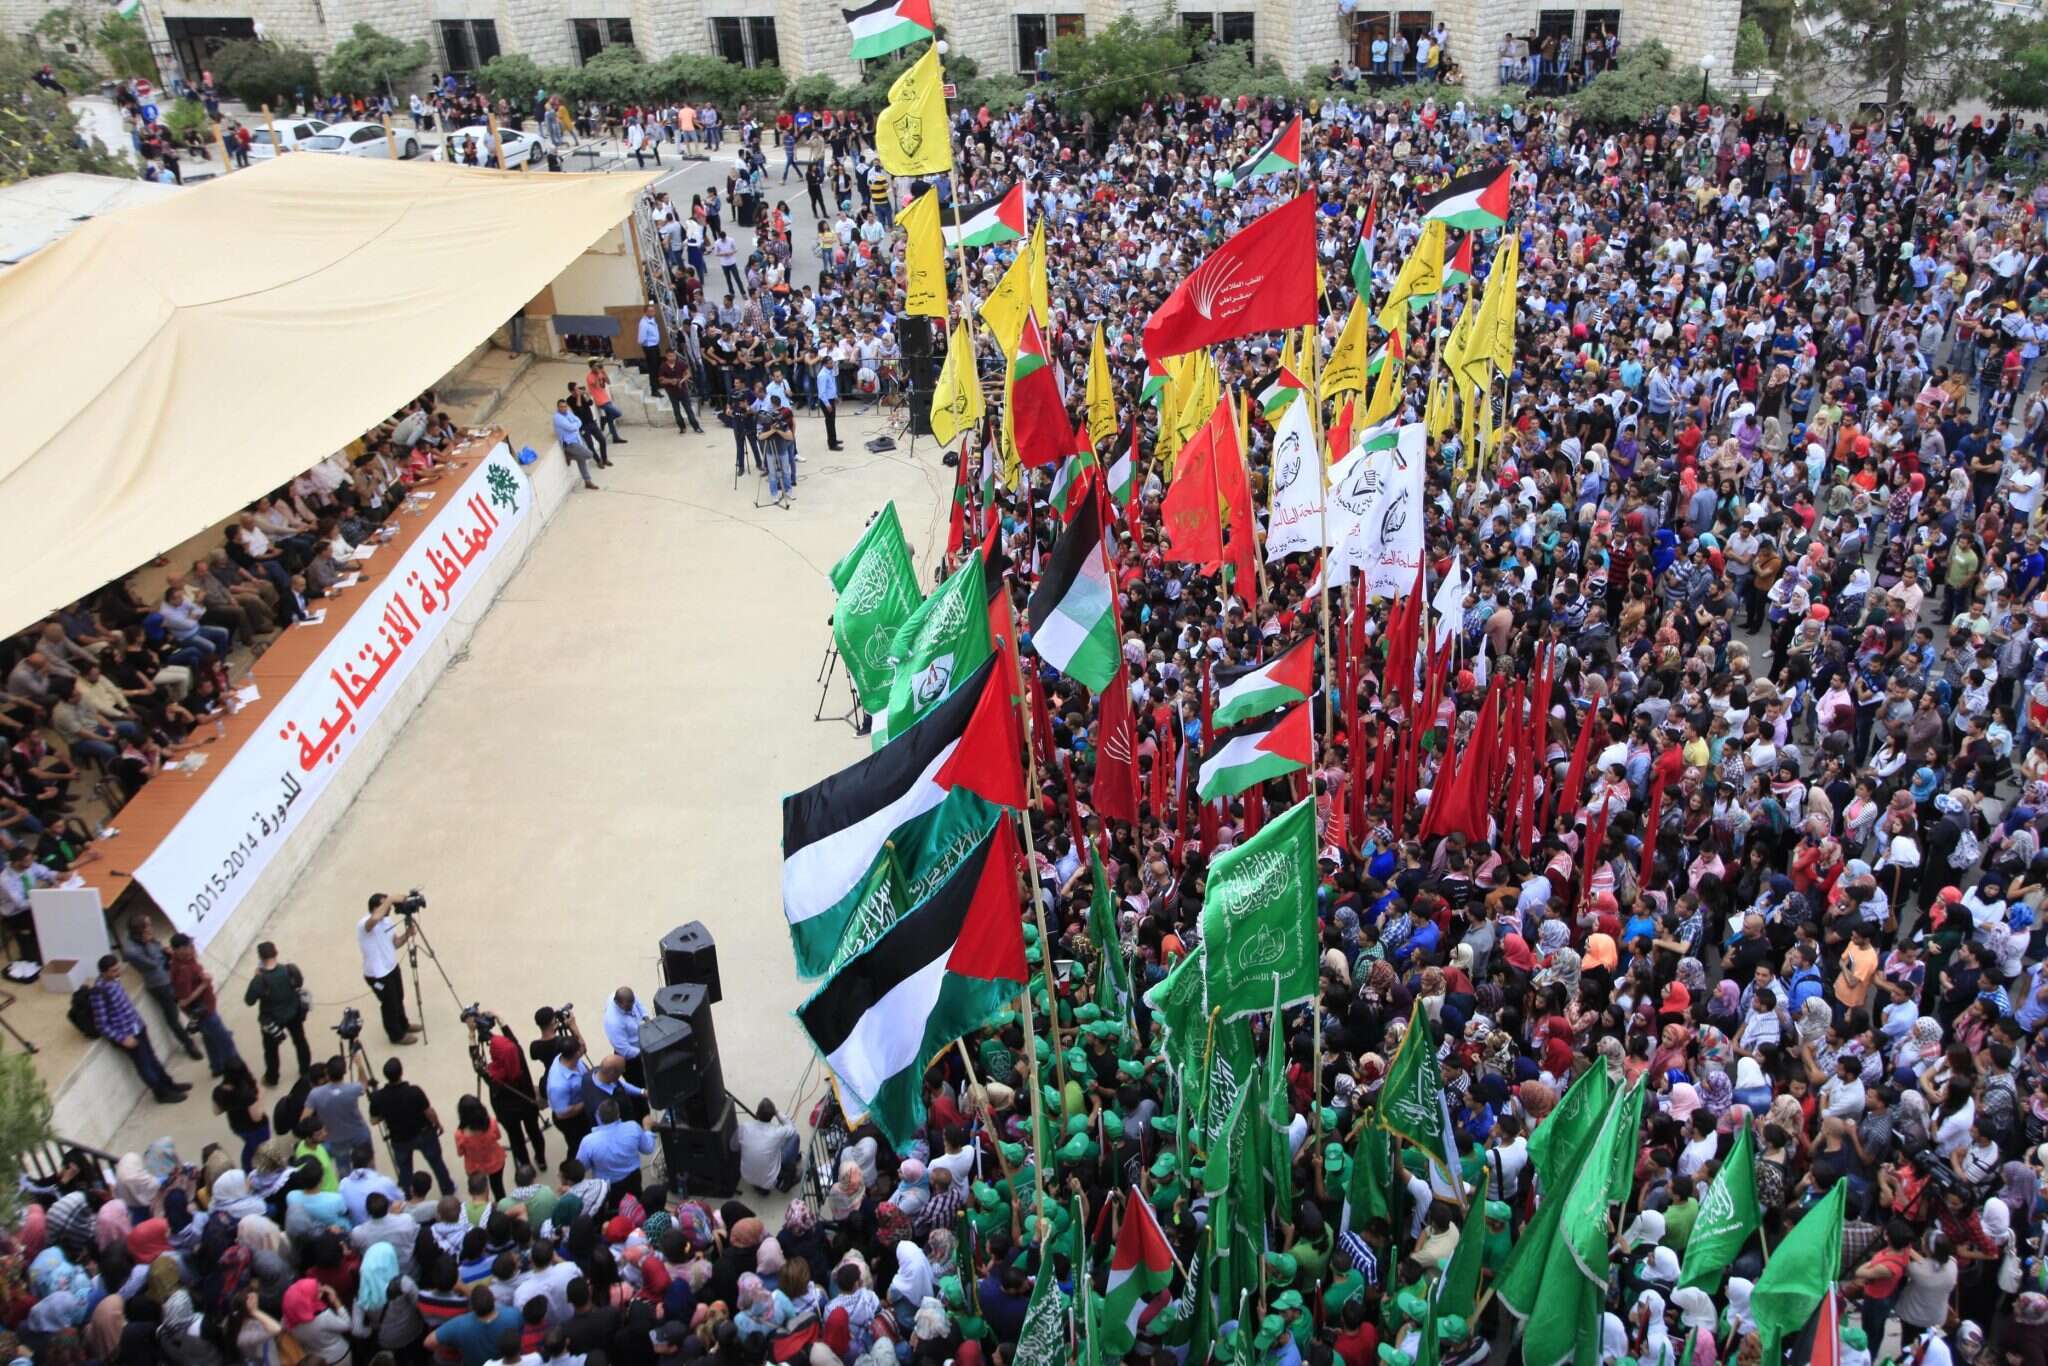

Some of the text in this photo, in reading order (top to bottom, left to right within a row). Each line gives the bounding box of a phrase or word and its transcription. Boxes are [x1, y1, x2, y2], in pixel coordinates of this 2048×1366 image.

[188, 493, 499, 923] المناظرة الانتخابية للدورة 2015-2014
